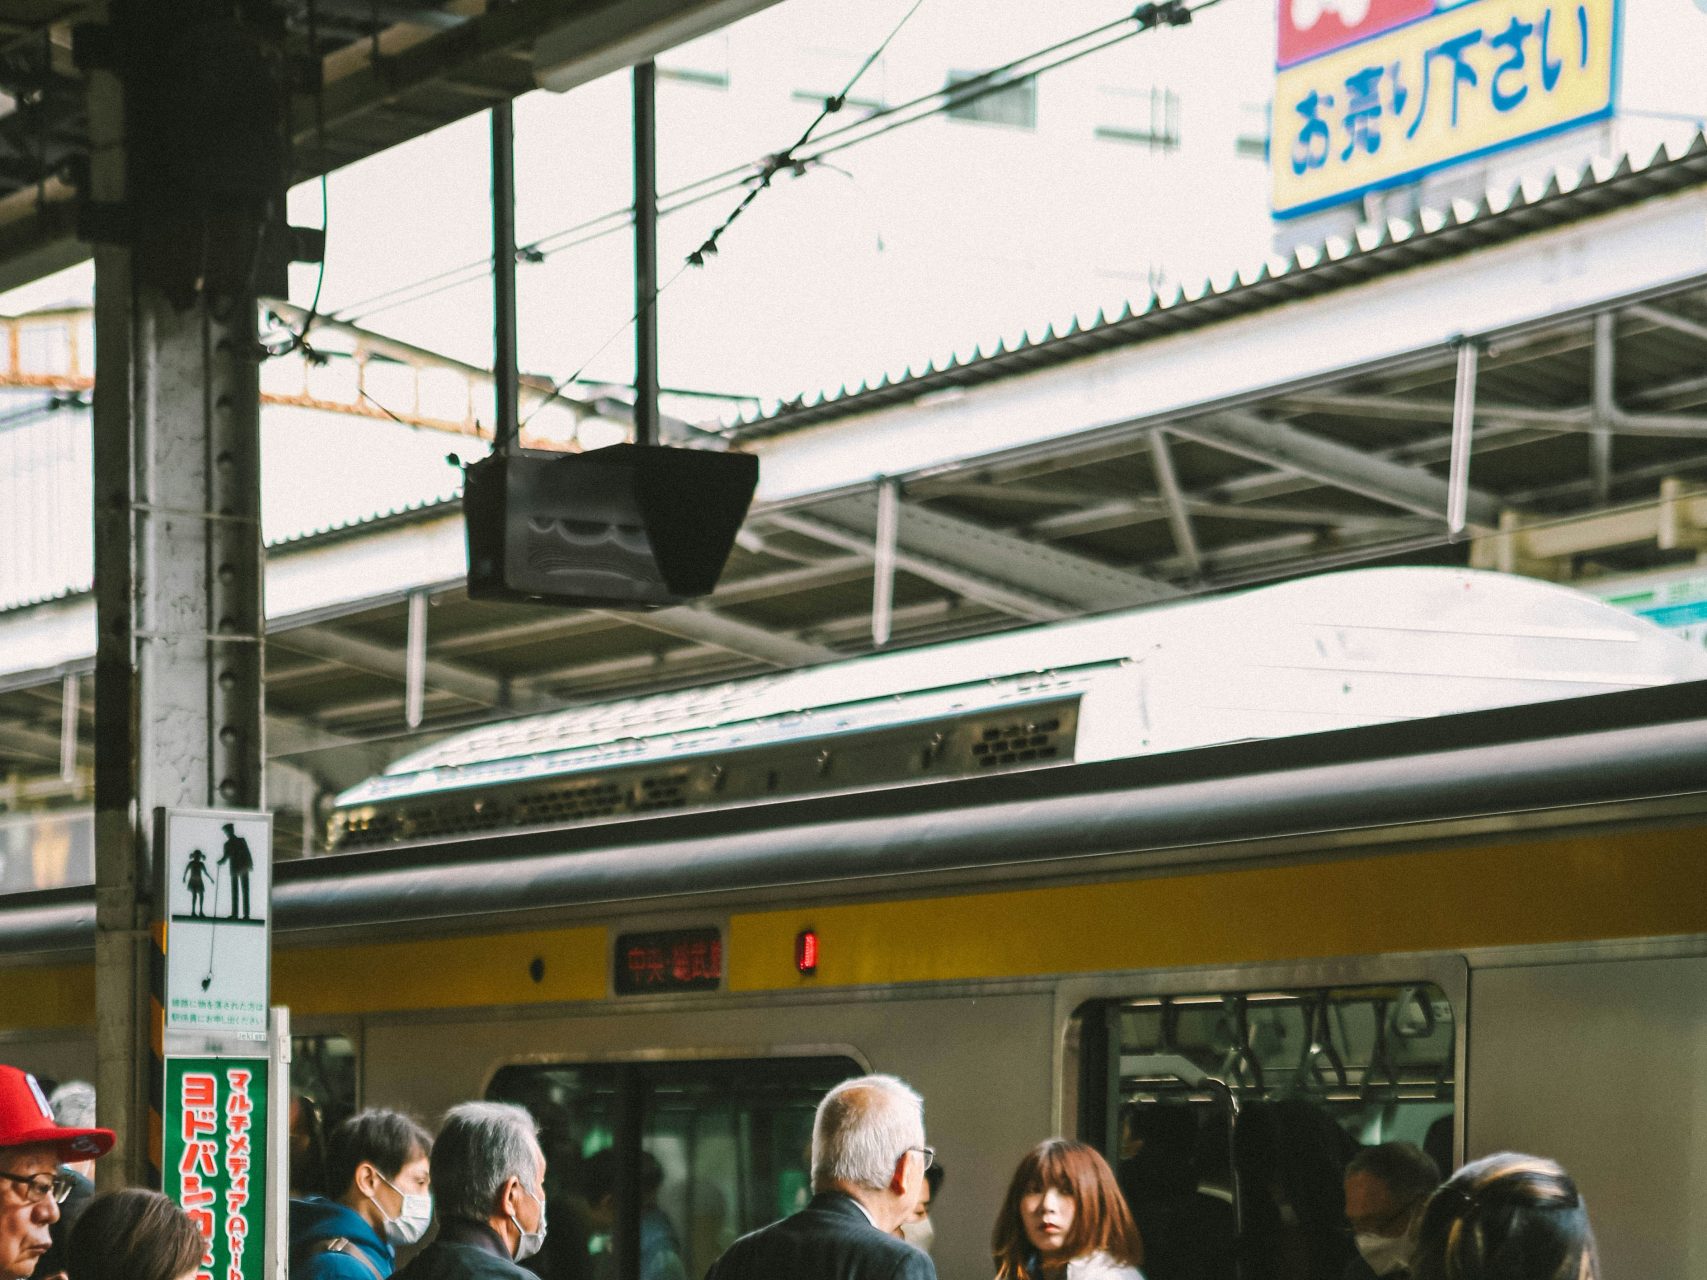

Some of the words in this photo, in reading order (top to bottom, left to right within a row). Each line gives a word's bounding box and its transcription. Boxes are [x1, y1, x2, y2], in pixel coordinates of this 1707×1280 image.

[1291, 5, 1588, 175] お売り下さい
